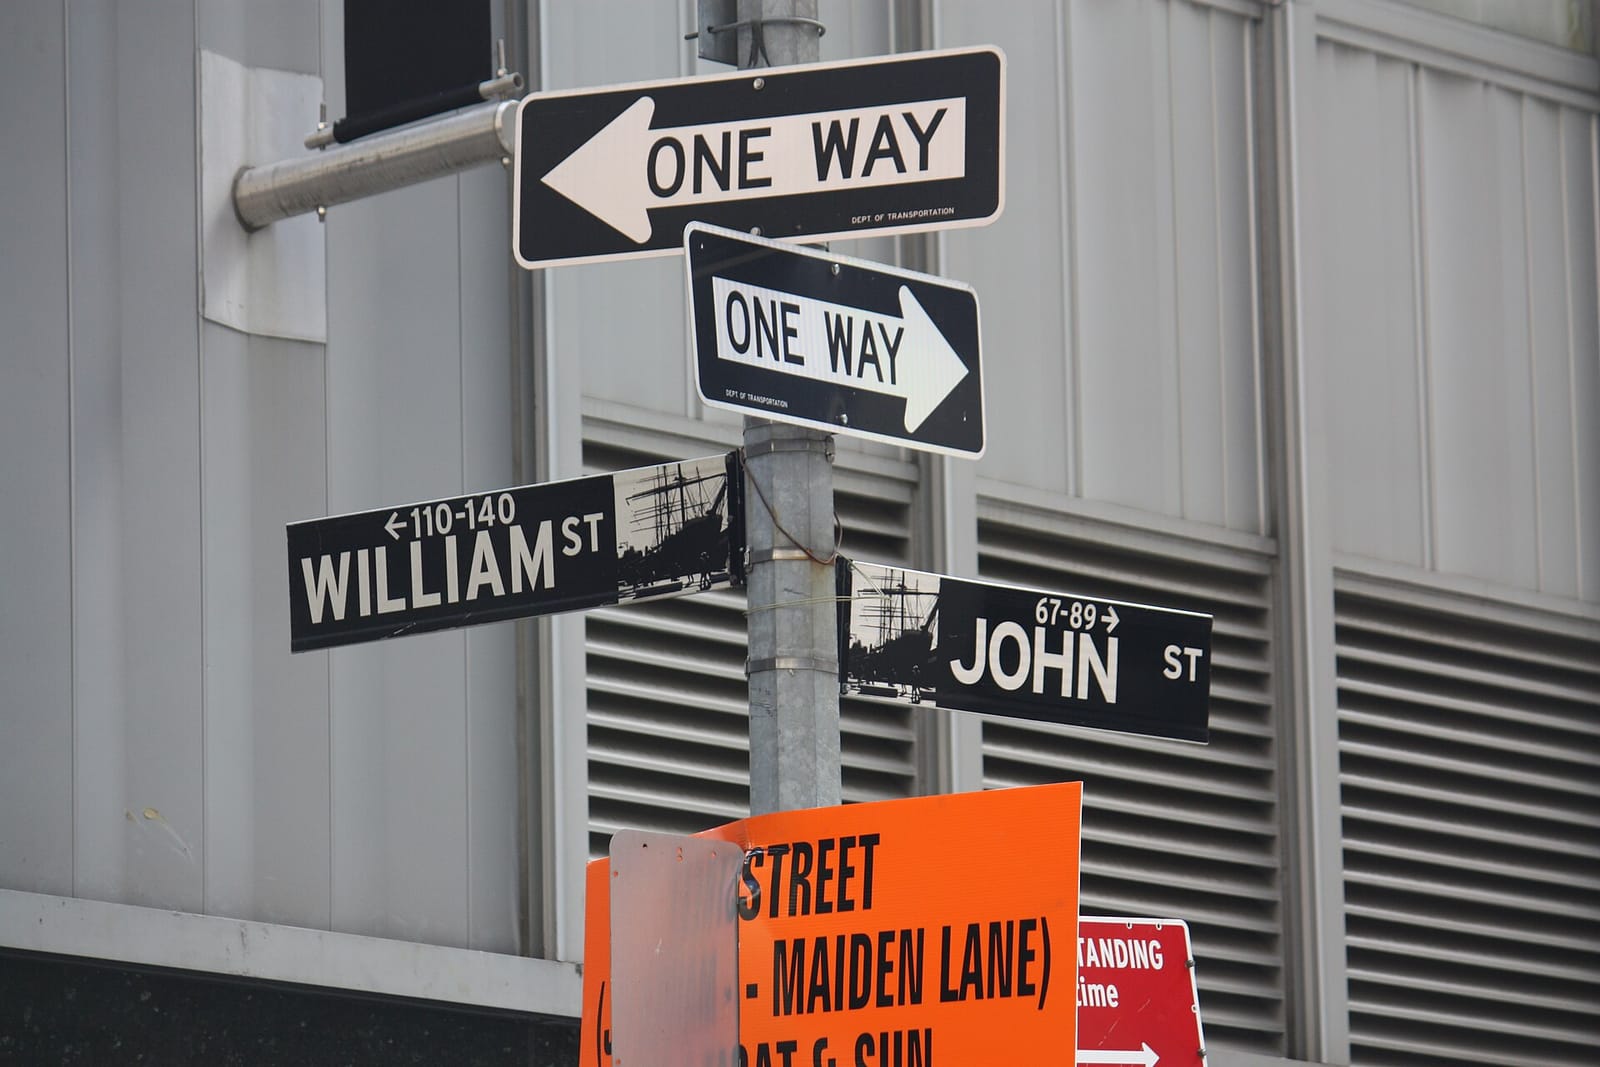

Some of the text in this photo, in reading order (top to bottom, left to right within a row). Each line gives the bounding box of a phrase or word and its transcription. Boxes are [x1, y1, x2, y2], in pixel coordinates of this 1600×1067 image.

[647, 108, 948, 198] ONE WAY
[851, 207, 955, 225] DEPT OF TRANSPORTATION
[726, 290, 905, 385] ONE WAY
[740, 391, 746, 399] OF
[747, 393, 788, 408] TRANSPORTATION
[410, 492, 515, 539] 110-140
[301, 512, 604, 625] WILLIAM ST
[1035, 597, 1097, 630] 67-89
[950, 617, 1203, 704] JOHN ST
[739, 833, 880, 921] STREET
[772, 927, 925, 1017] MAIDEN
[939, 916, 1051, 1011] LANE)
